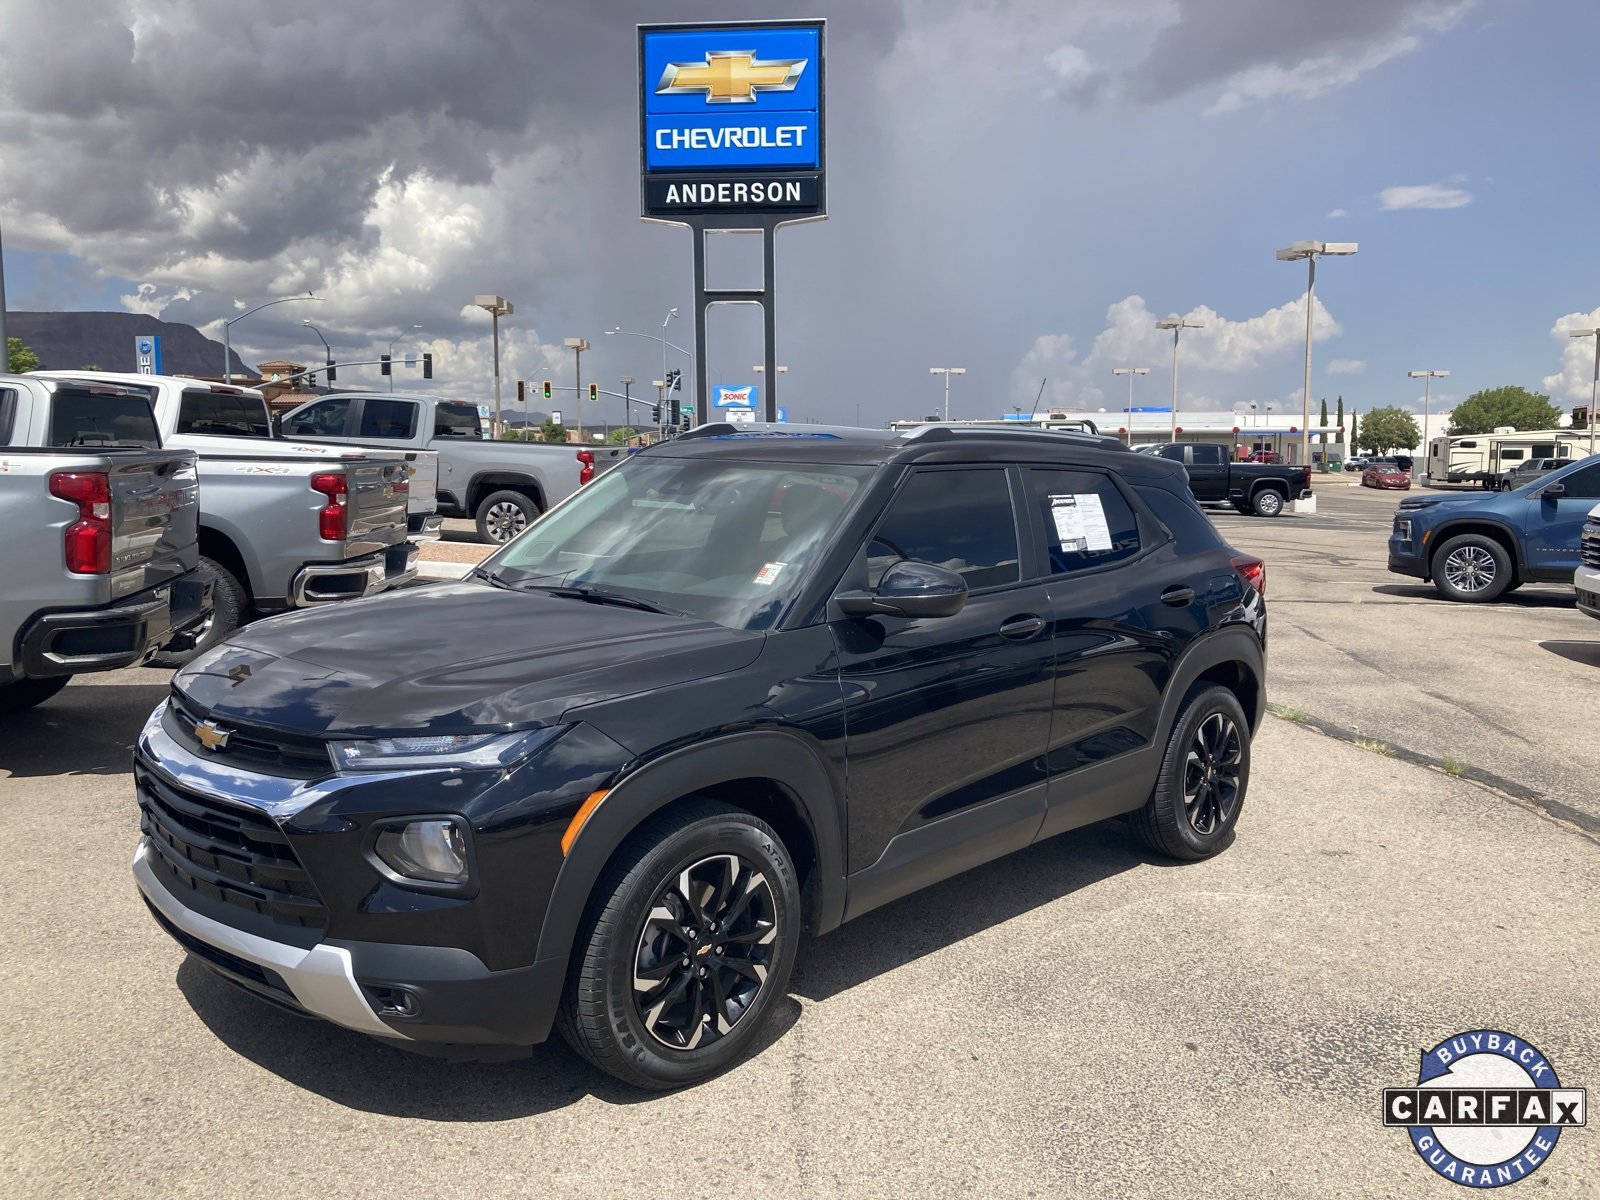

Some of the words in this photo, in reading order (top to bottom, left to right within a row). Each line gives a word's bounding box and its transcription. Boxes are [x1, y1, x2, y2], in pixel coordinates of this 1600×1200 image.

[655, 125, 808, 150] CHEVROLET
[665, 181, 801, 204] ANDERSON
[723, 393, 747, 401] SONIC
